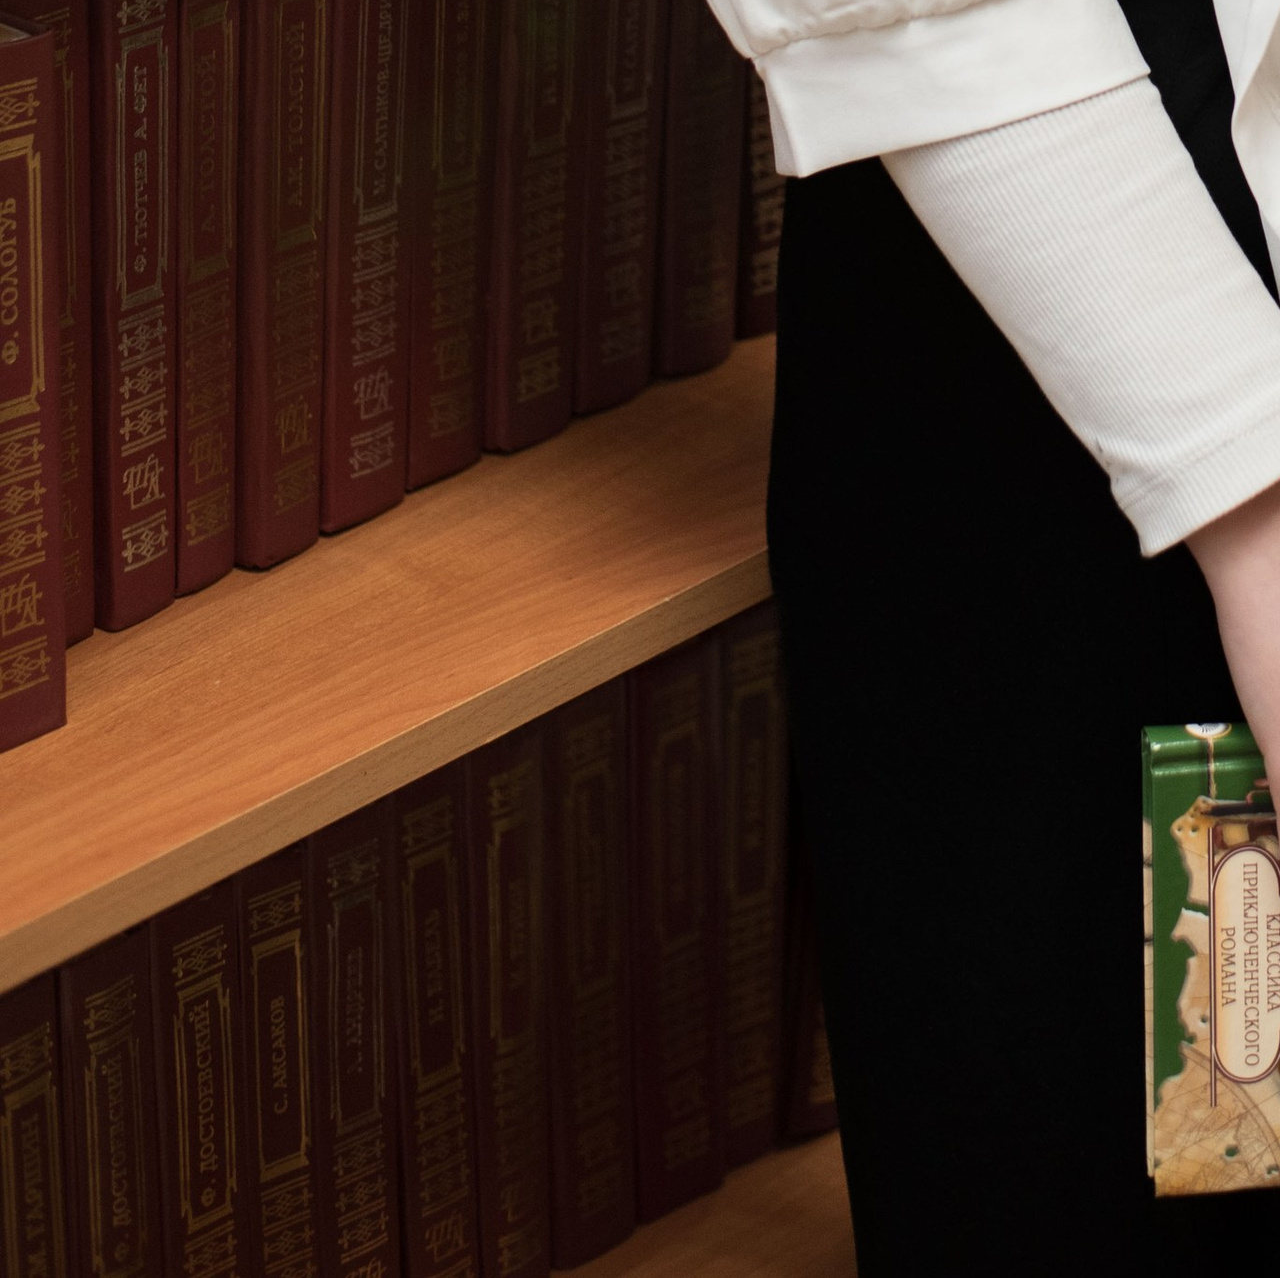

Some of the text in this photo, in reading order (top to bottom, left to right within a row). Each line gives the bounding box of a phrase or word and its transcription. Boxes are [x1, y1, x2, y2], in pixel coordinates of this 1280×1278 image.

[133, 61, 148, 115] ФЕТ
[195, 49, 217, 201] ТОЛСТОЙ
[284, 20, 305, 153] ТОЛСТОЙ
[0, 197, 19, 364] Ф. СОЛОГУБ
[133, 246, 148, 274] Ф.
[1221, 927, 1237, 1008] РОМАНА
[1243, 863, 1260, 1067] ПРИКЛЮЧЕНЧЕСКОГО
[188, 999, 218, 1208] Ф. ДОСТОЕВСКИЙ
[270, 994, 288, 1115] С. АКСАКОВ
[22, 1113, 46, 1242] ГАРШИН
[101, 1051, 132, 1228] ДОСТОЕВСКИЙ
